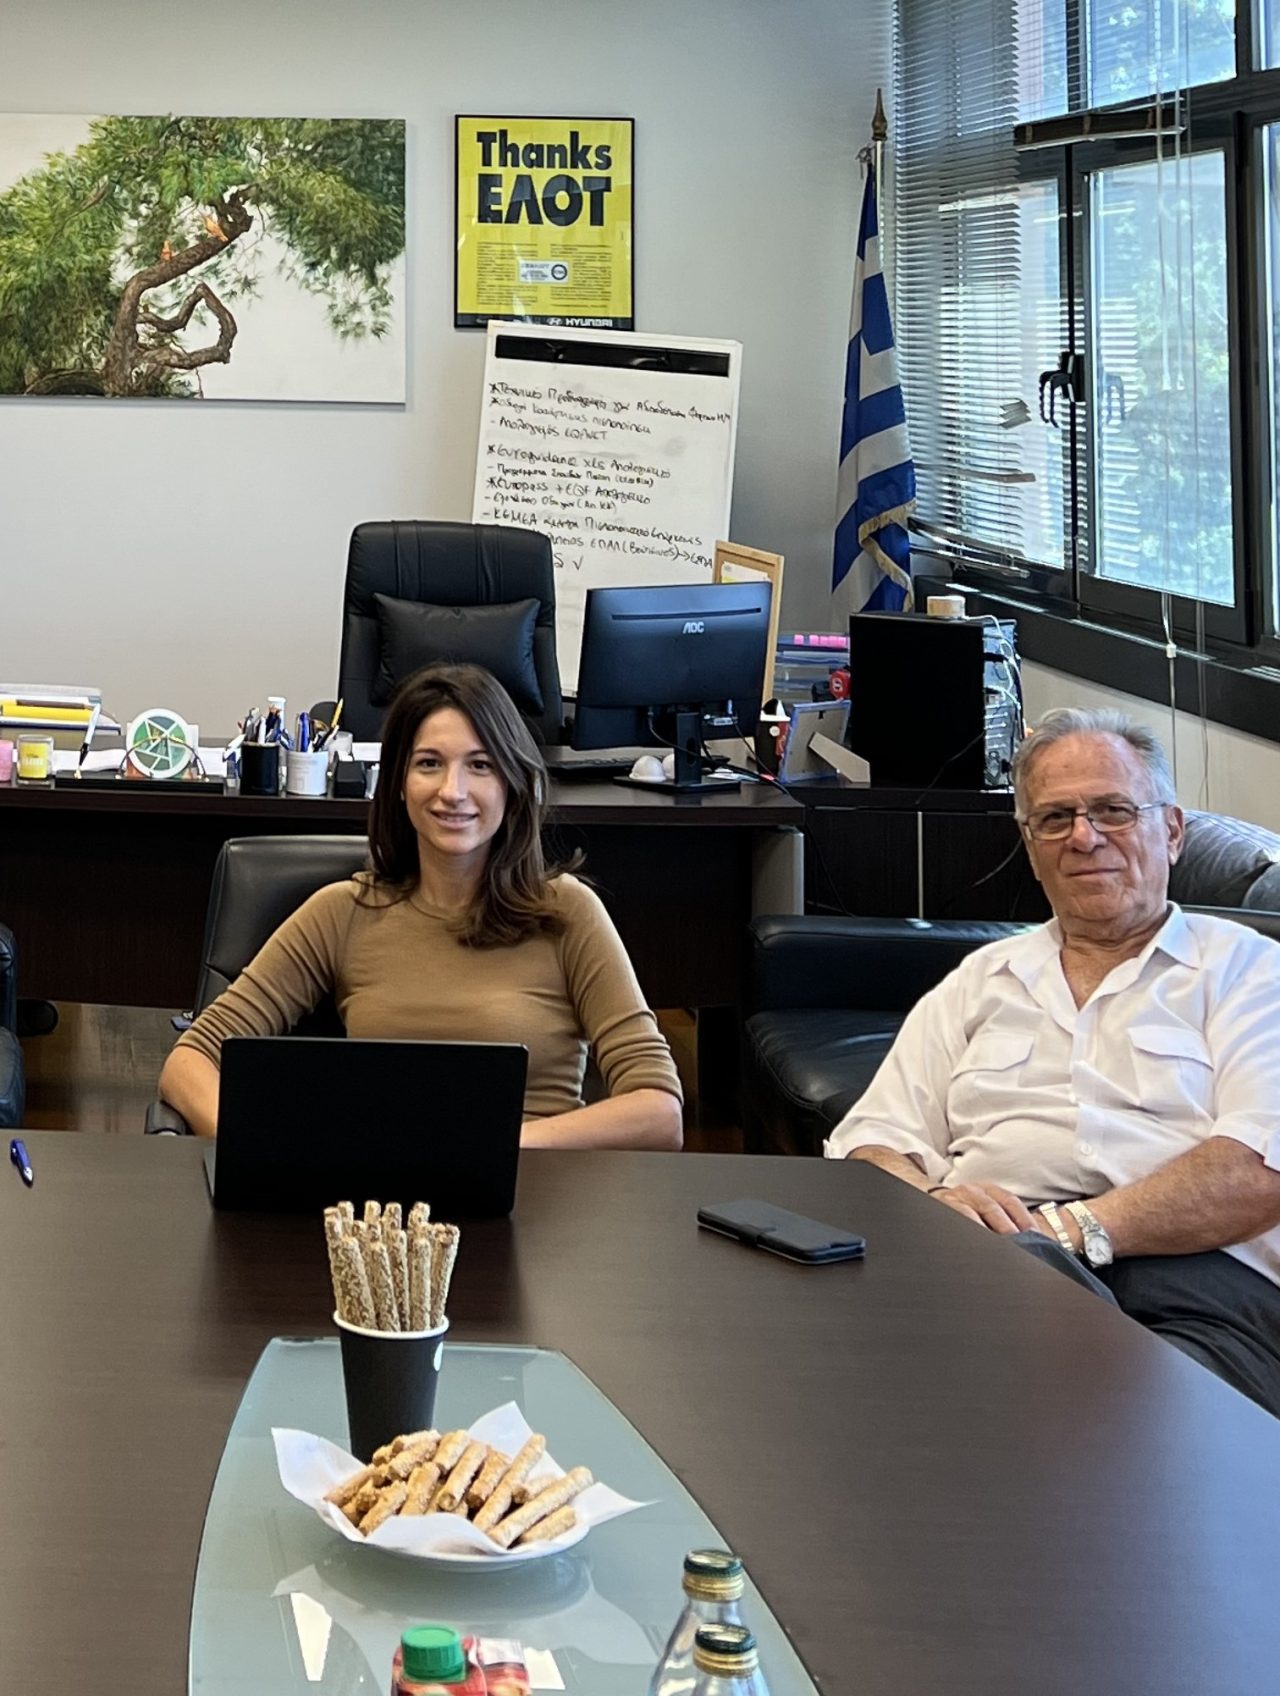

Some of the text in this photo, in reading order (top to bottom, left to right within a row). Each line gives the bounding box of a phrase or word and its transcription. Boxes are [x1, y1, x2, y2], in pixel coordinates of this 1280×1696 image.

[476, 129, 613, 170] Thanks
[477, 173, 612, 227] ΕΛΟΤ
[565, 317, 613, 327] HYUNDAI
[682, 621, 705, 634] AOC
